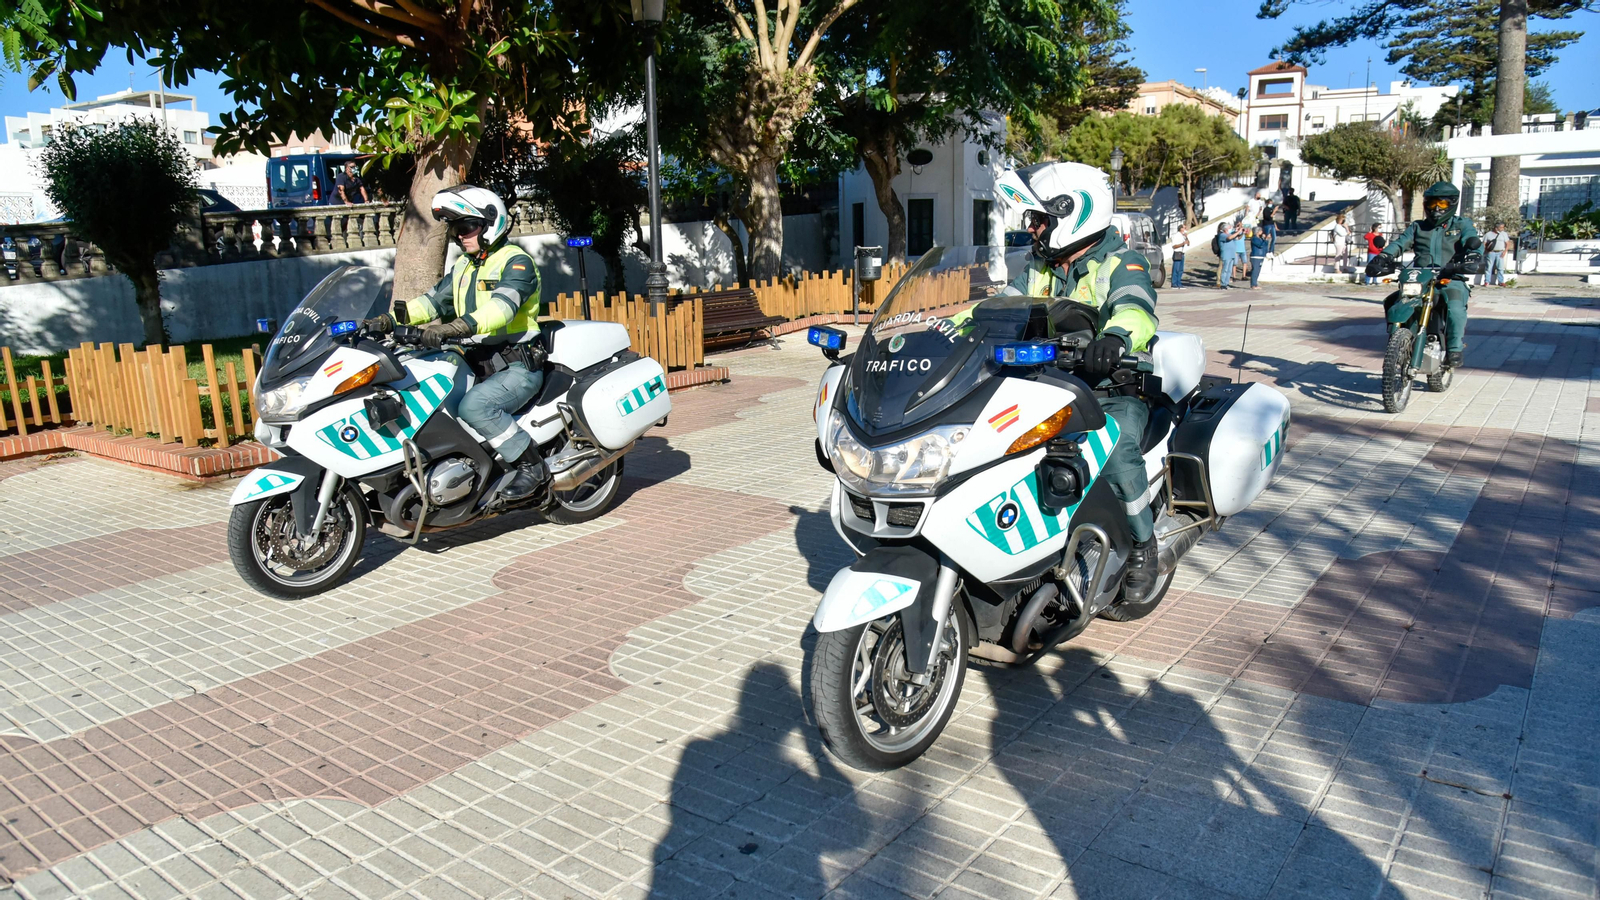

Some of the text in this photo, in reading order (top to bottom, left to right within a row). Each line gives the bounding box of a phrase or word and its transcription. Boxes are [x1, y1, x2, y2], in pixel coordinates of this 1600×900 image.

[303, 307, 320, 323] CIVIL
[872, 312, 959, 343] GUARDIA CIVIL
[865, 358, 932, 372] TRAFICO
